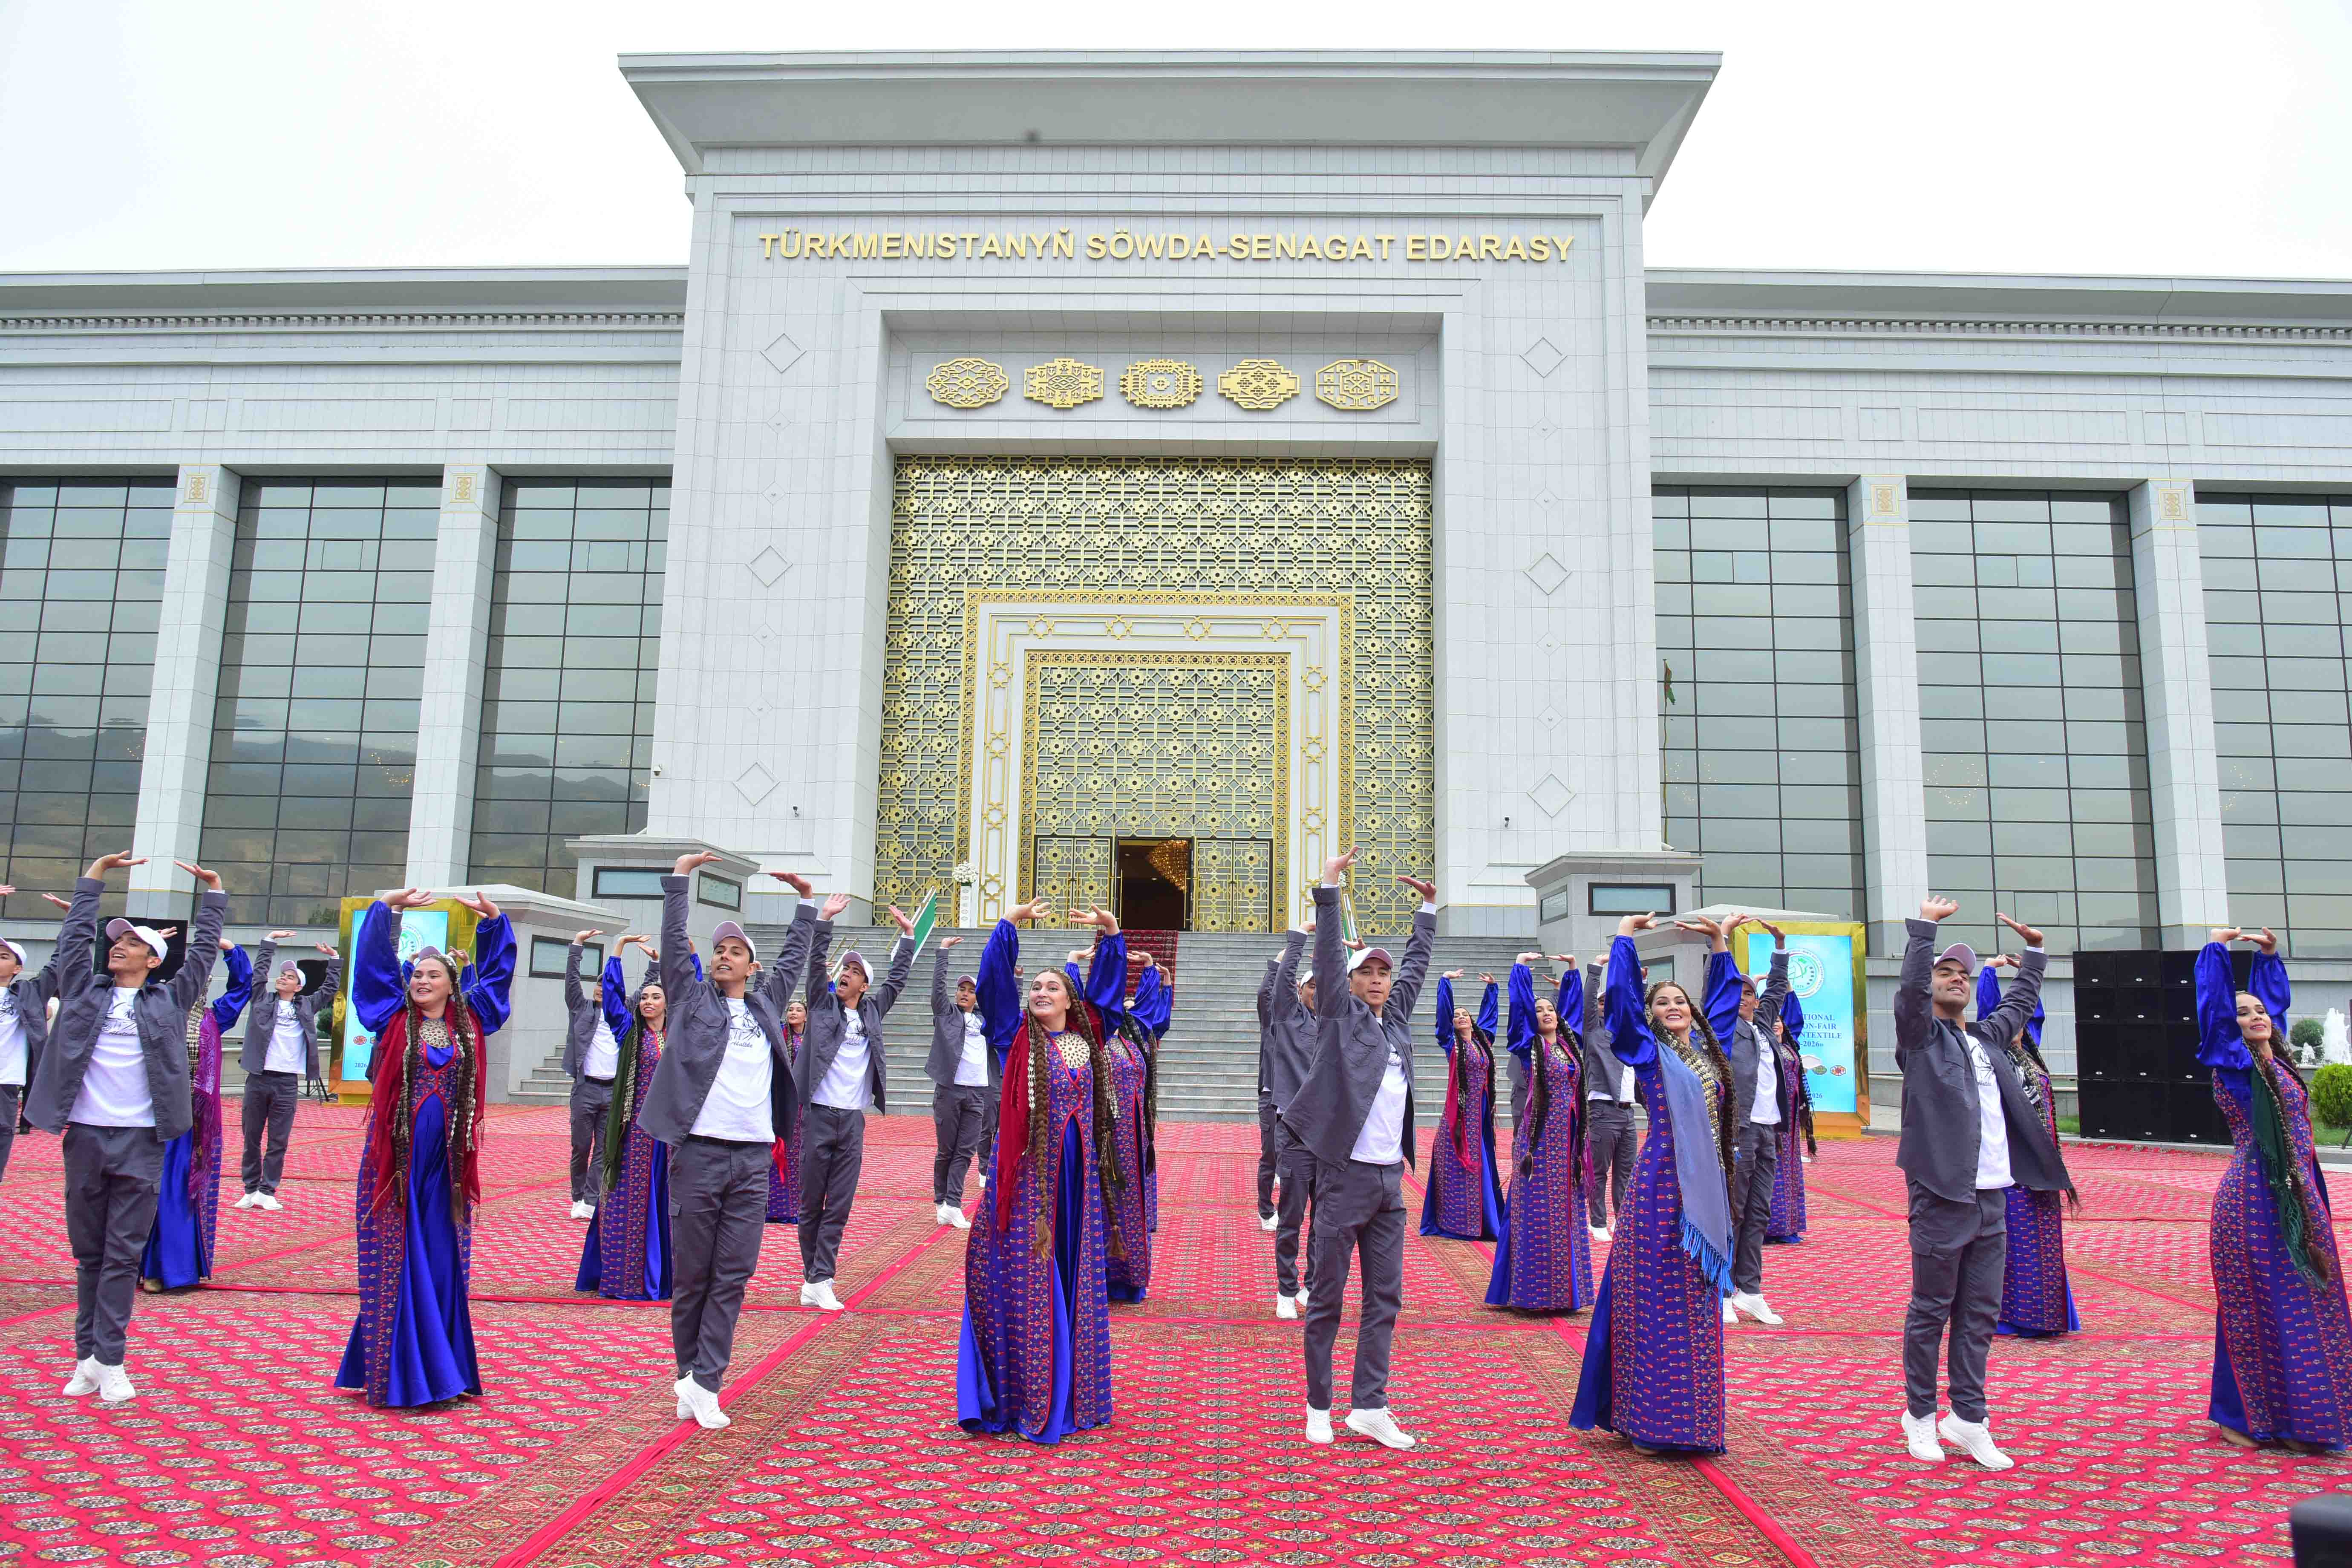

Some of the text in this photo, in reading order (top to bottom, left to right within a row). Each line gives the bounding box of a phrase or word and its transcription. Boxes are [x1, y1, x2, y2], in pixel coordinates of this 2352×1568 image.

[759, 227, 1575, 260] TÜRKMENISTANYŇ SÖWDA-SENAGAT EDARASY
